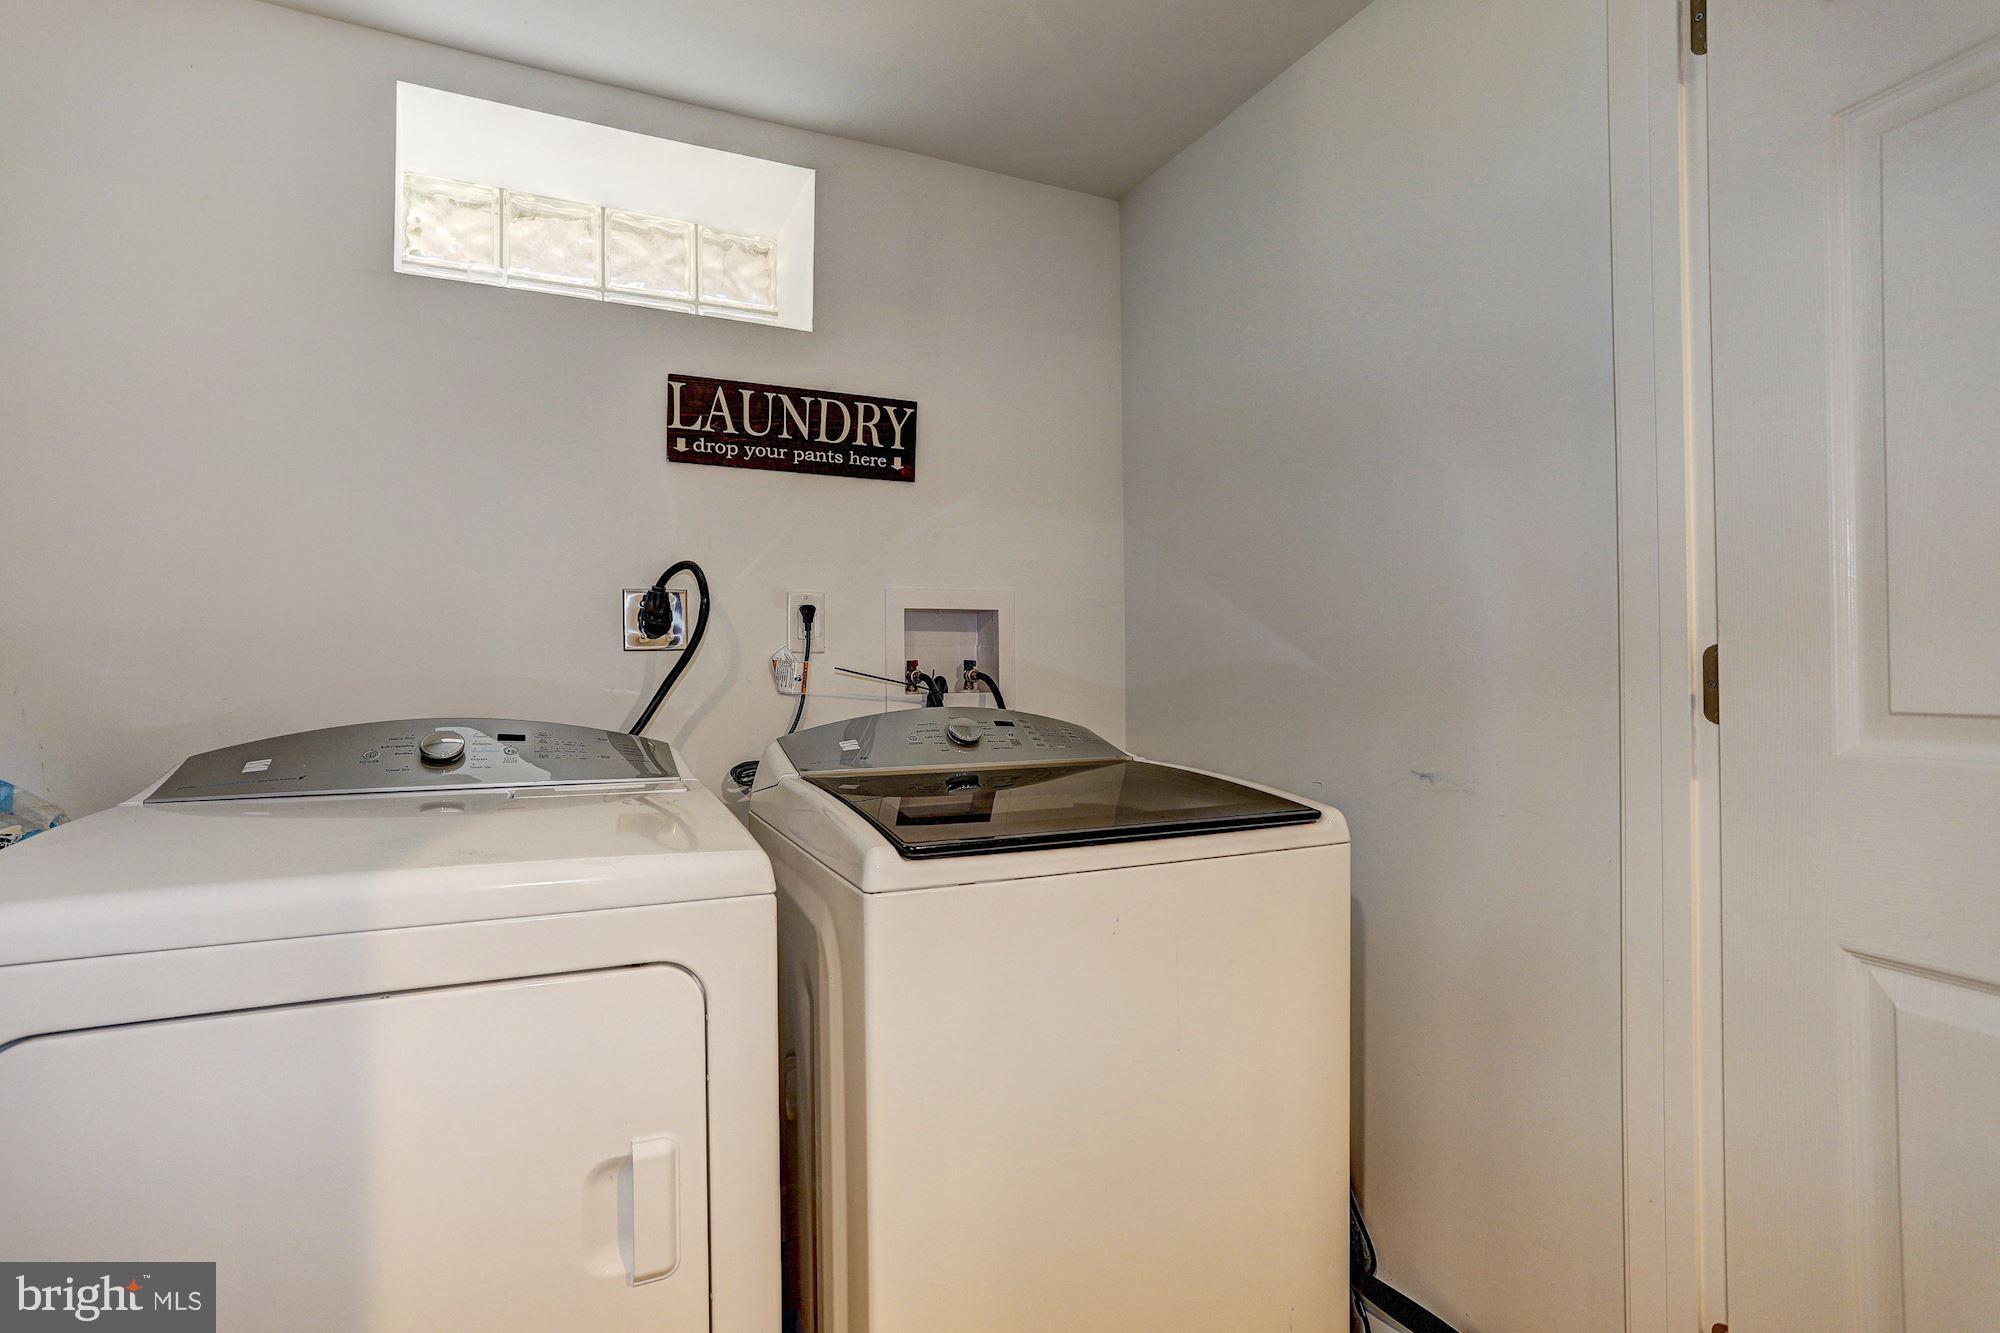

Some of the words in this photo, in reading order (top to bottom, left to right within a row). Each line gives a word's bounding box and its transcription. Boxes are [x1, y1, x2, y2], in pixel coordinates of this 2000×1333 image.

[667, 381, 915, 450] LAUNDRY
[693, 438, 739, 460] drop
[743, 443, 788, 460] your
[793, 449, 844, 464] pants
[849, 450, 887, 467] here
